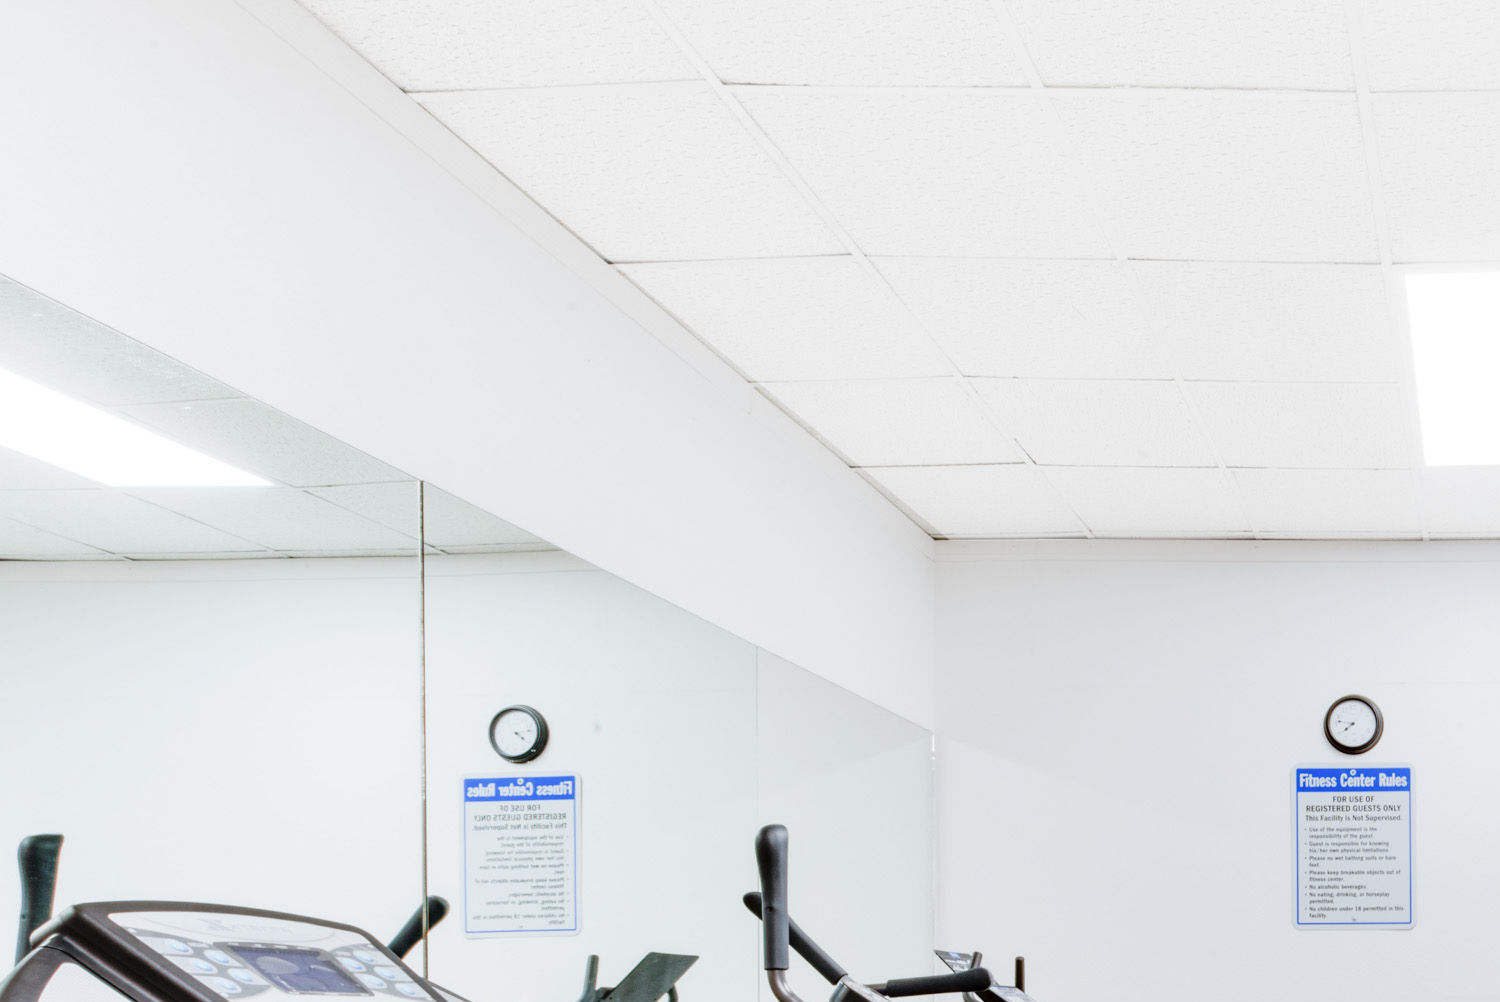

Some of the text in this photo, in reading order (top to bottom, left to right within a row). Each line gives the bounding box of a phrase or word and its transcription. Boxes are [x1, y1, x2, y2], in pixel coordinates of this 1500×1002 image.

[1299, 772, 1408, 788] Fitness Center Rules
[1332, 795, 1375, 803] FOR USE OF
[1306, 804, 1401, 813] REGISTERED GUESTS ONLY
[1320, 815, 1344, 823] Facility
